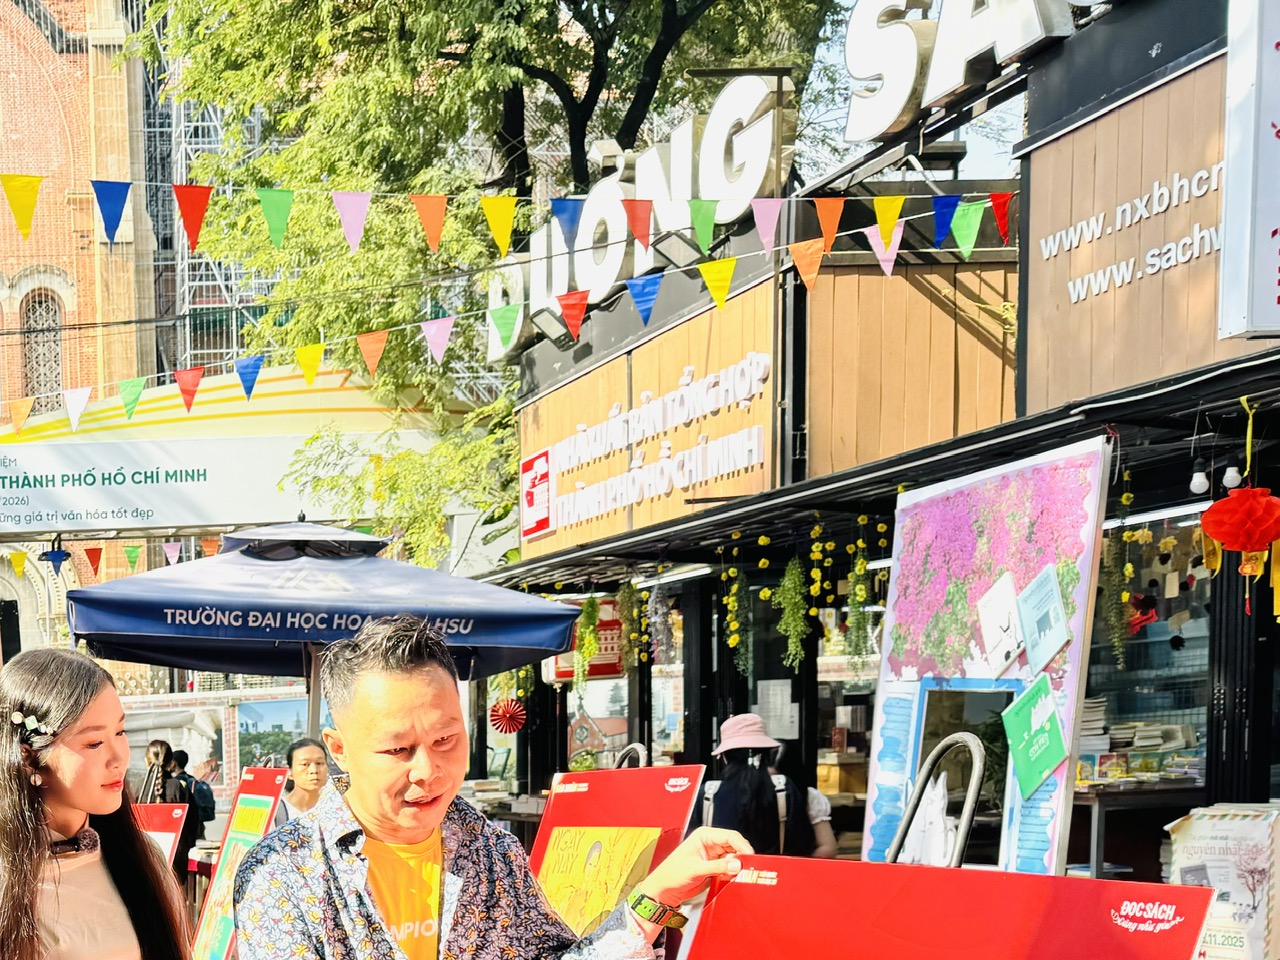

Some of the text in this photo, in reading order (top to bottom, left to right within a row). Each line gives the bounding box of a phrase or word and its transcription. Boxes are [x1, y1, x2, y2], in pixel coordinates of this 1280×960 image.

[61, 467, 96, 487] PHỐ
[101, 466, 126, 486] HỒ
[131, 466, 160, 485] CHÍ
[165, 468, 207, 484] MINH
[25, 510, 43, 527] giá
[46, 511, 58, 524] trị
[61, 510, 83, 521] văn
[86, 508, 108, 520] hóa
[111, 507, 128, 519] tốt
[131, 507, 154, 522] đẹp
[164, 606, 243, 627] TRƯỜNG
[248, 610, 280, 632] ĐẠI
[286, 611, 328, 632] HỌC
[1120, 900, 1176, 920] ĐỌC SÁCH
[390, 918, 438, 941] MPIO
